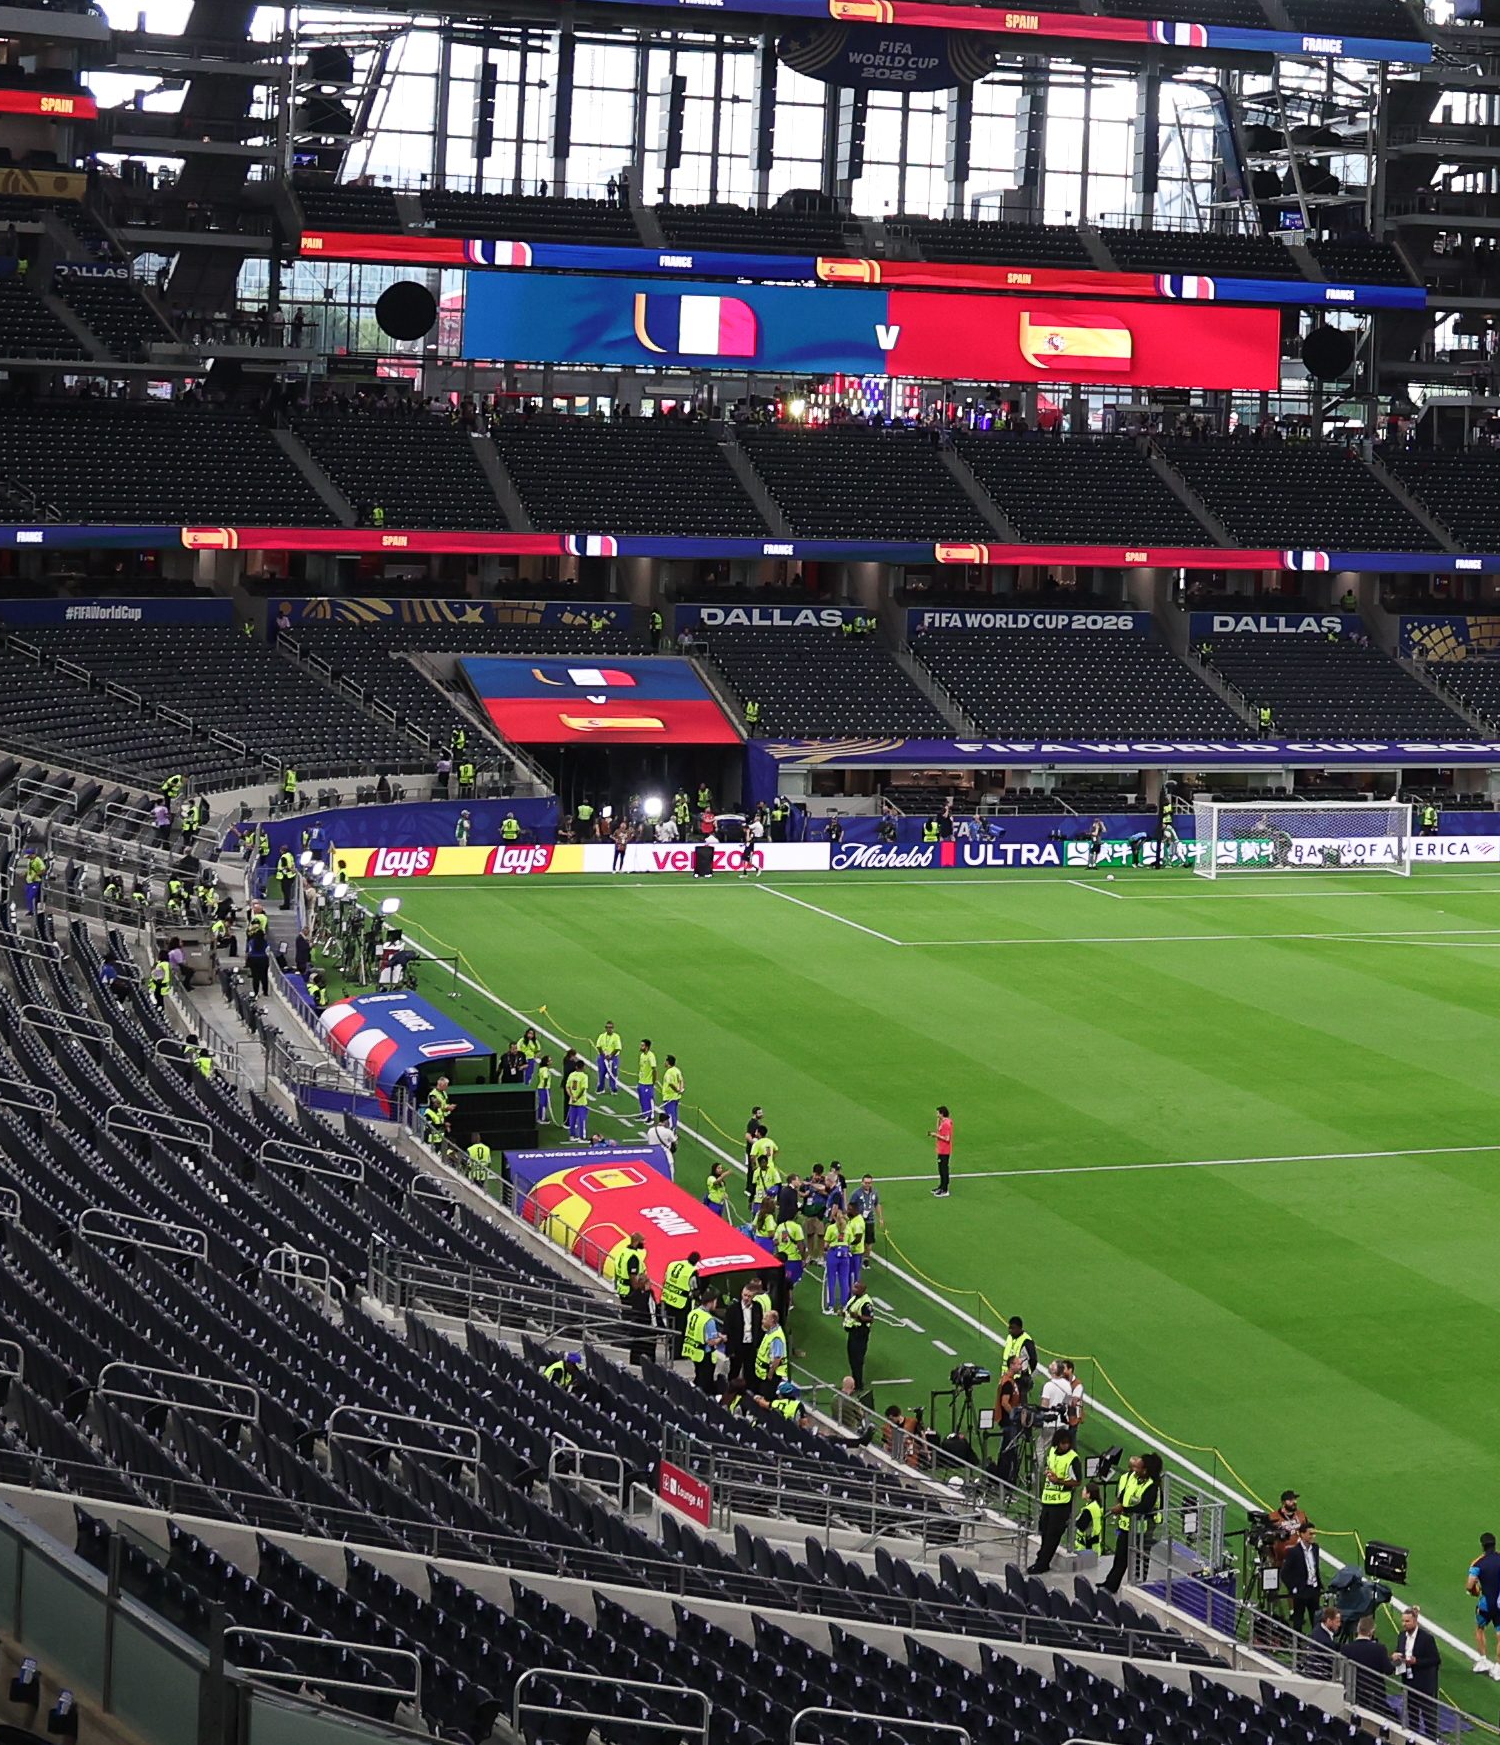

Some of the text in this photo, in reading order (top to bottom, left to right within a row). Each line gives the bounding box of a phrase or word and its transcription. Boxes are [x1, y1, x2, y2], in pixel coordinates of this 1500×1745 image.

[1006, 14, 1038, 29] SPAIN
[878, 40, 913, 56] FIFA
[1303, 38, 1342, 53] FRANCE
[847, 51, 940, 70] WORLD CUP
[859, 66, 919, 81] 2026
[41, 98, 73, 113] SPAIN
[301, 237, 324, 250] PAIN
[1008, 273, 1031, 284] SPAIN
[764, 544, 793, 555] FRANCE
[1126, 552, 1147, 562] SPAIN
[1456, 559, 1481, 569] FRANCE
[66, 606, 141, 621] #FIFAWorldCup
[700, 607, 844, 629] DALLAS
[924, 613, 1133, 629] FIFA WORLD CUP 2026
[1213, 616, 1342, 633] DALLAS
[953, 743, 1081, 753] FIFA
[1084, 743, 1280, 753] WORLD
[1286, 744, 1389, 754] CUP
[373, 847, 431, 878] Lay's
[492, 845, 546, 875] Lay's
[832, 842, 1060, 870] Michelob ULTRA
[388, 1009, 435, 1032] FRANCE
[639, 1206, 699, 1236] SPAIN
[677, 1485, 696, 1506] Lounge
